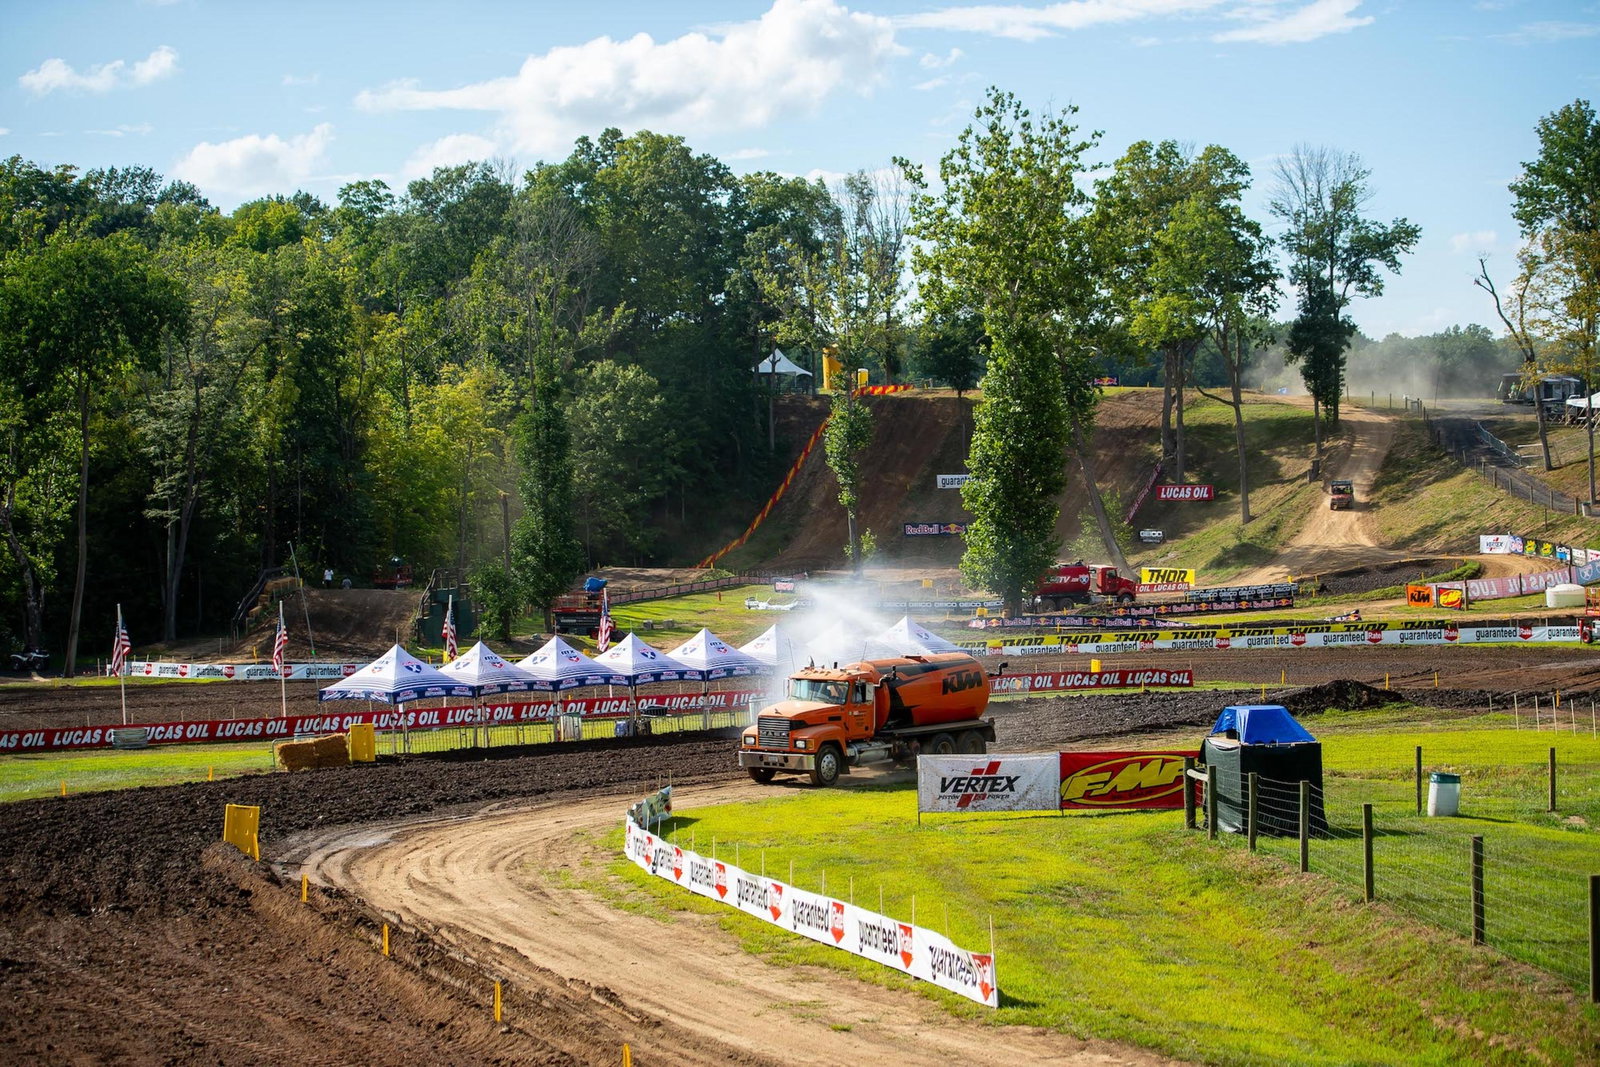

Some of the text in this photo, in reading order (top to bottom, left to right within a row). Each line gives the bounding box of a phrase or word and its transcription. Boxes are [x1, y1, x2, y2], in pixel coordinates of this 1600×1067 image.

[941, 476, 972, 487] guarant
[1161, 487, 1209, 498] LUCAS OIL
[1148, 569, 1188, 583] THOR
[1153, 583, 1176, 591] LUCAS
[1410, 590, 1430, 603] KTM
[1323, 633, 1365, 645] guaranteed
[1400, 630, 1442, 643] guaranteed
[1476, 628, 1517, 640] guaranteed
[1548, 628, 1580, 639] guarantee
[1020, 644, 1062, 655] guaranteed
[1096, 642, 1138, 653] guaranteed
[1171, 639, 1214, 650] guaranteed
[196, 666, 223, 678] guaranteed
[306, 665, 356, 677] guaranteed Rate
[1126, 671, 1190, 684] LUCAS OIL
[942, 669, 983, 696] KTM
[1034, 675, 1053, 688] OIL
[1059, 672, 1120, 687] LUCAS OIL
[708, 694, 726, 707] OIL
[494, 706, 514, 720] OIL
[566, 702, 587, 715] OIL
[294, 716, 340, 733] LUCAS
[372, 711, 440, 728] LUCAS OIL
[145, 723, 209, 741] UCAS OIL
[215, 720, 288, 737] LUCAS OIL
[22, 732, 46, 747] OIL
[52, 729, 102, 746] LUCAS
[940, 775, 1021, 793] VERTEX
[792, 898, 830, 932] guaranteed
[858, 919, 898, 956] guaranteed
